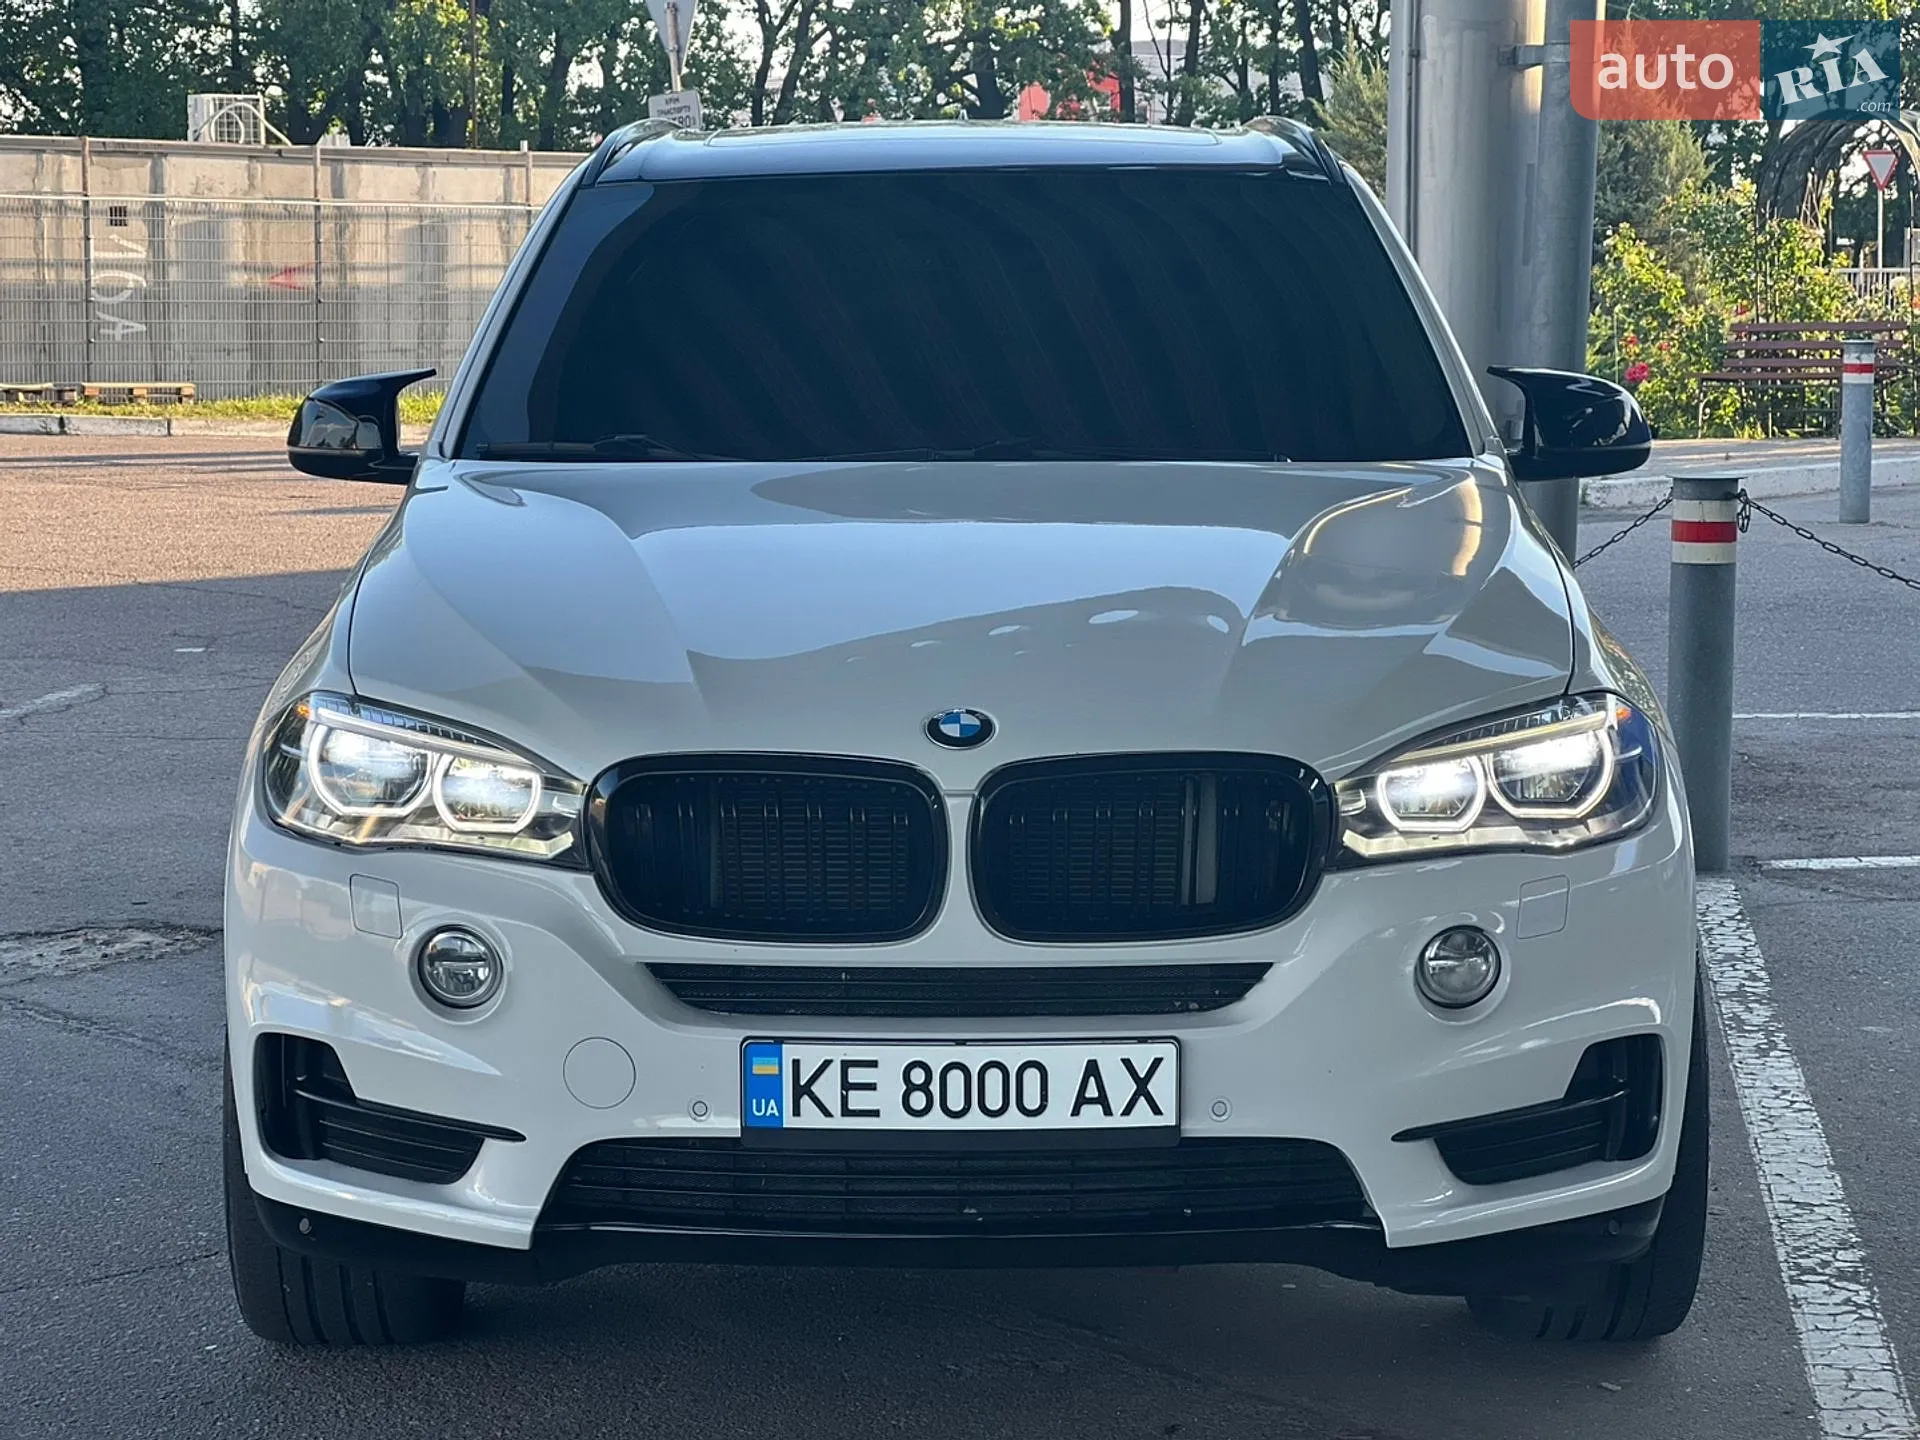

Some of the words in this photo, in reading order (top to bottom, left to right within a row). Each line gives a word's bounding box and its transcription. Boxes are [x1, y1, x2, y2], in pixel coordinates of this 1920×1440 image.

[791, 1058, 881, 1118] KE
[901, 1059, 1049, 1118] 8000
[1070, 1056, 1165, 1117] AX
[752, 1099, 780, 1117] UA
